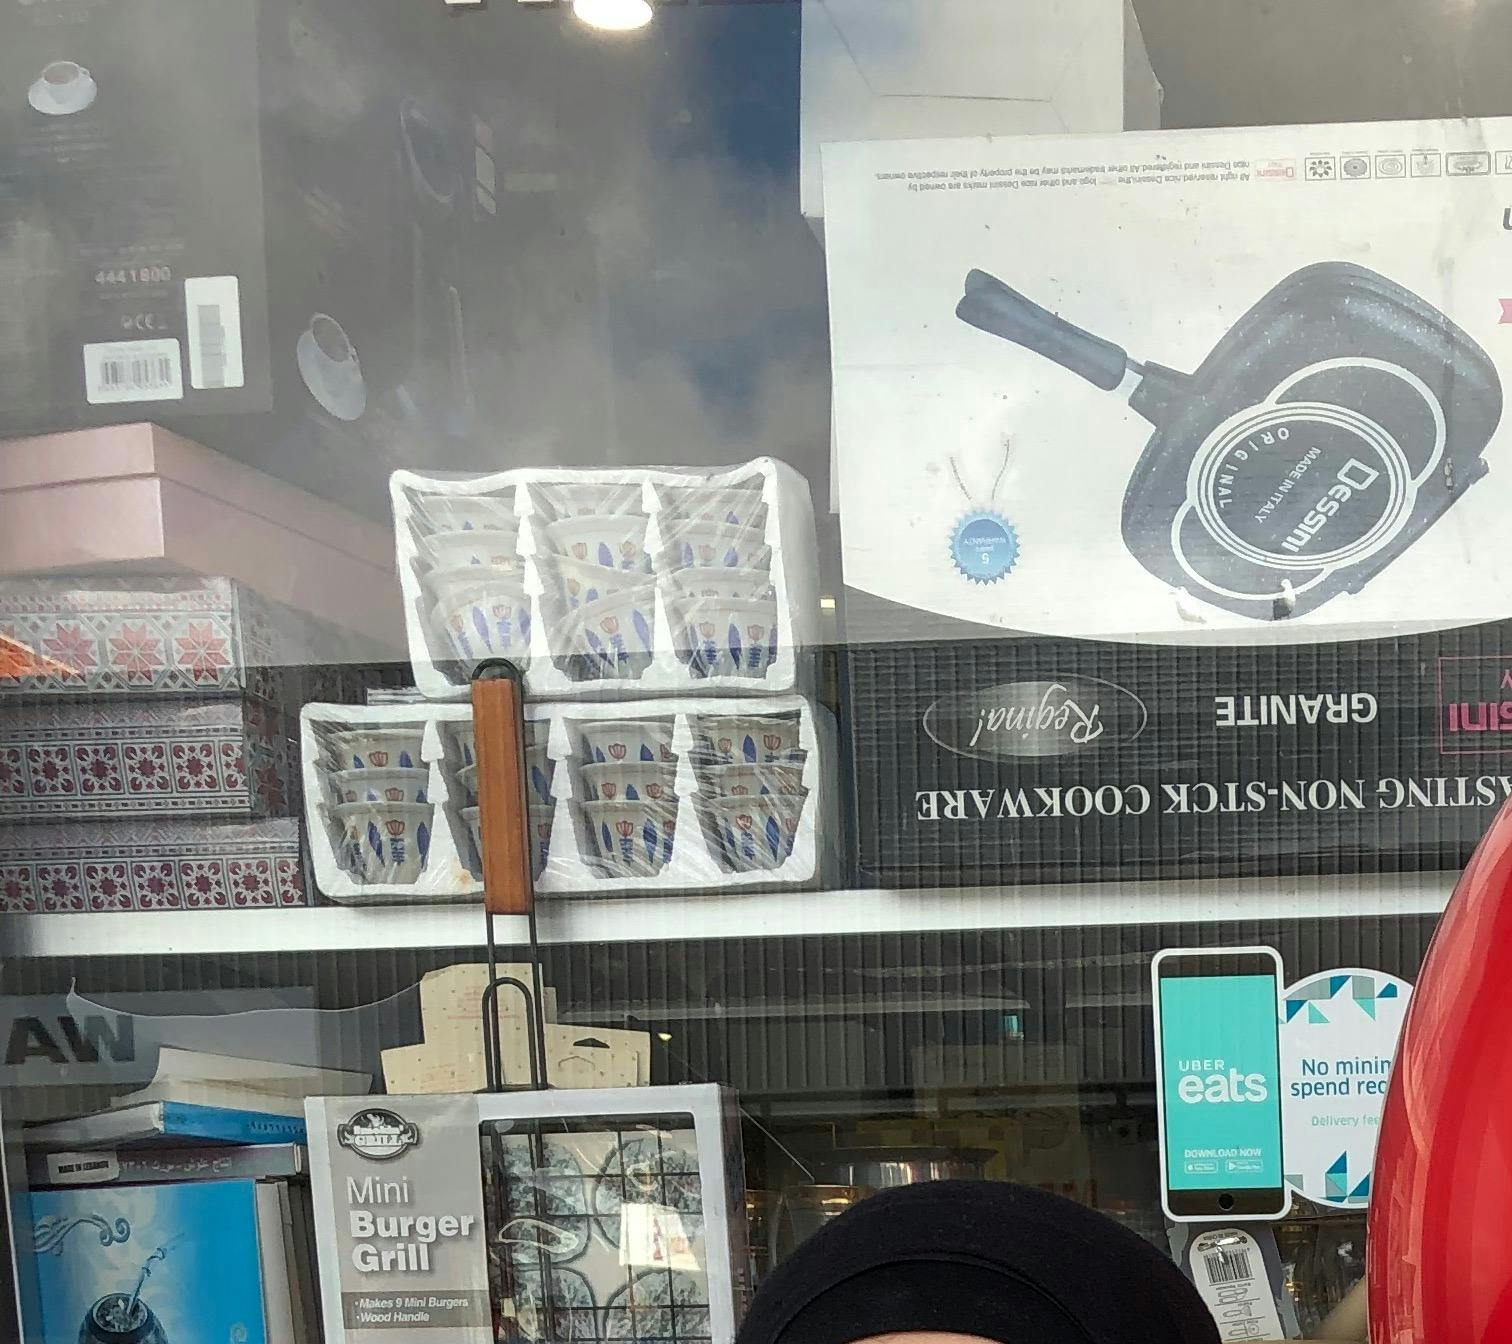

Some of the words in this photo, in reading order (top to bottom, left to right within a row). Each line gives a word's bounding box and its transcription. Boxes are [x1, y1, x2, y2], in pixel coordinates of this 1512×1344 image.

[1219, 427, 1290, 508] ORIGINAL
[1290, 446, 1321, 480] MADE
[1279, 477, 1294, 496] IN
[1254, 494, 1283, 524] ITALY
[981, 553, 990, 564] 5
[970, 684, 1104, 748] Regina!
[1215, 691, 1377, 727] GRANITE
[916, 783, 1151, 820] COOKWARE
[1164, 778, 1372, 816] NON-STCK
[1178, 1059, 1225, 1072] UBER
[1302, 1058, 1329, 1076] No
[1178, 1067, 1268, 1104] eats
[1291, 1078, 1350, 1099] spend
[1311, 1116, 1359, 1128] Delivery
[1184, 1148, 1238, 1159] DOWNLOAD
[1239, 1148, 1262, 1157] NOW
[347, 1176, 409, 1204] Mini
[350, 1210, 474, 1242] Burger
[352, 1243, 430, 1272] Grill
[360, 1311, 391, 1322] Wood
[394, 1310, 430, 1322] Handle
[395, 1298, 402, 1308] 9
[404, 1297, 426, 1308] Mini
[428, 1297, 469, 1309] Burgers
